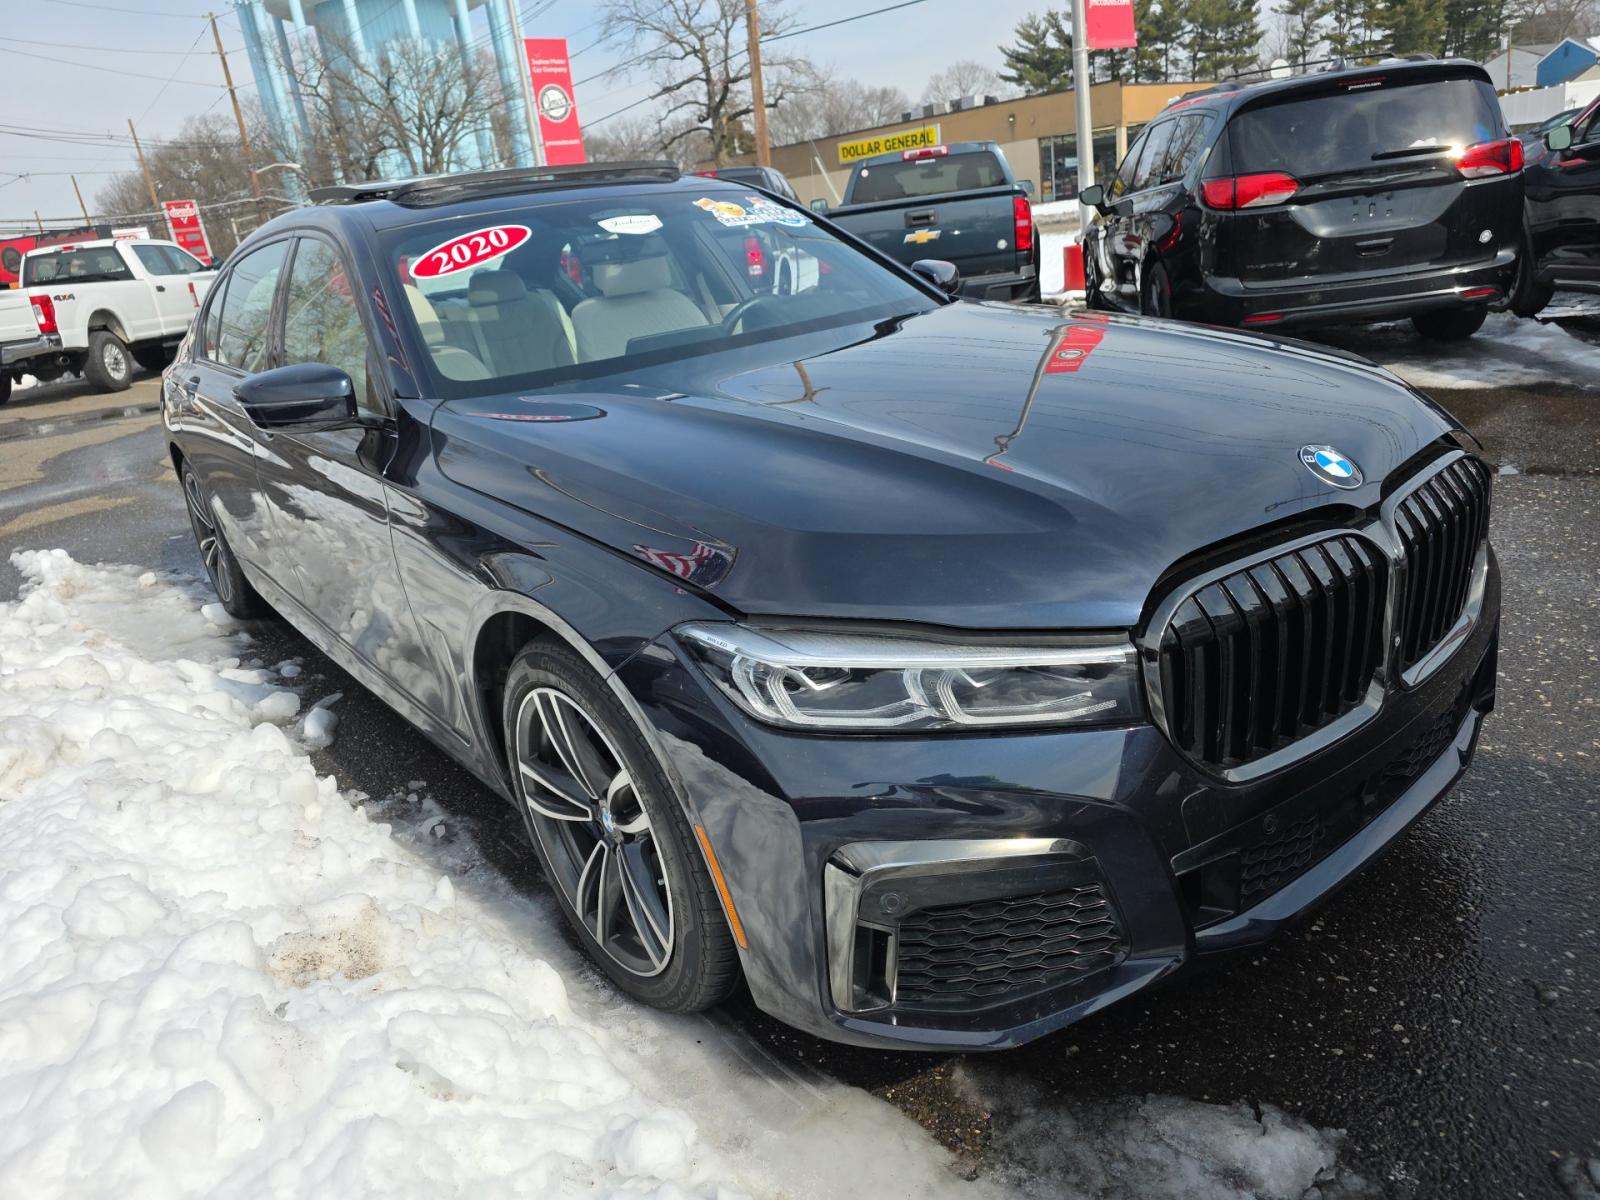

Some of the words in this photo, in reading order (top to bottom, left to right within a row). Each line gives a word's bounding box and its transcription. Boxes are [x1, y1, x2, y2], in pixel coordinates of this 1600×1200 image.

[841, 142, 880, 158] DOLLAR
[884, 133, 933, 151] GENERAL
[431, 229, 509, 274] 2020
